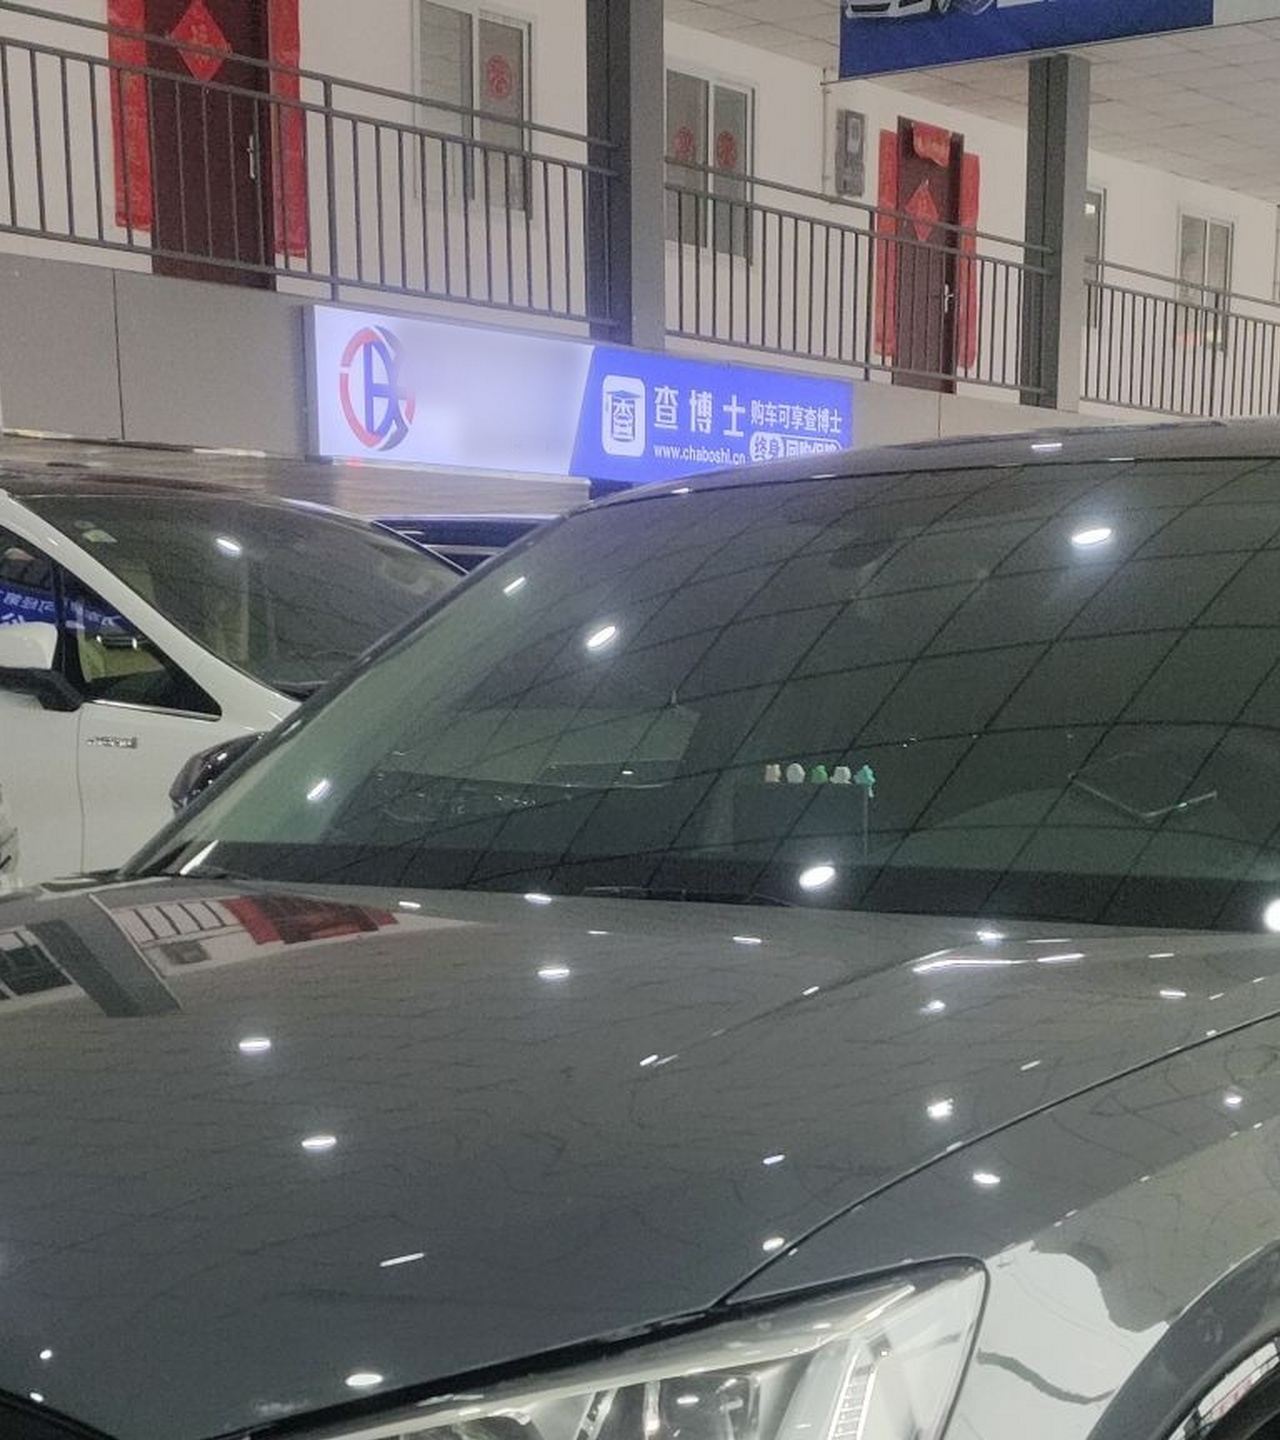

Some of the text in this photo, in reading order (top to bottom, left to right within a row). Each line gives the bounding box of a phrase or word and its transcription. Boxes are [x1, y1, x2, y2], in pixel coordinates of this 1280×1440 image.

[653, 385, 746, 438] 查博士
[750, 400, 842, 434] 购车可享查博士
[653, 443, 746, 466] www.chaboshi.cn
